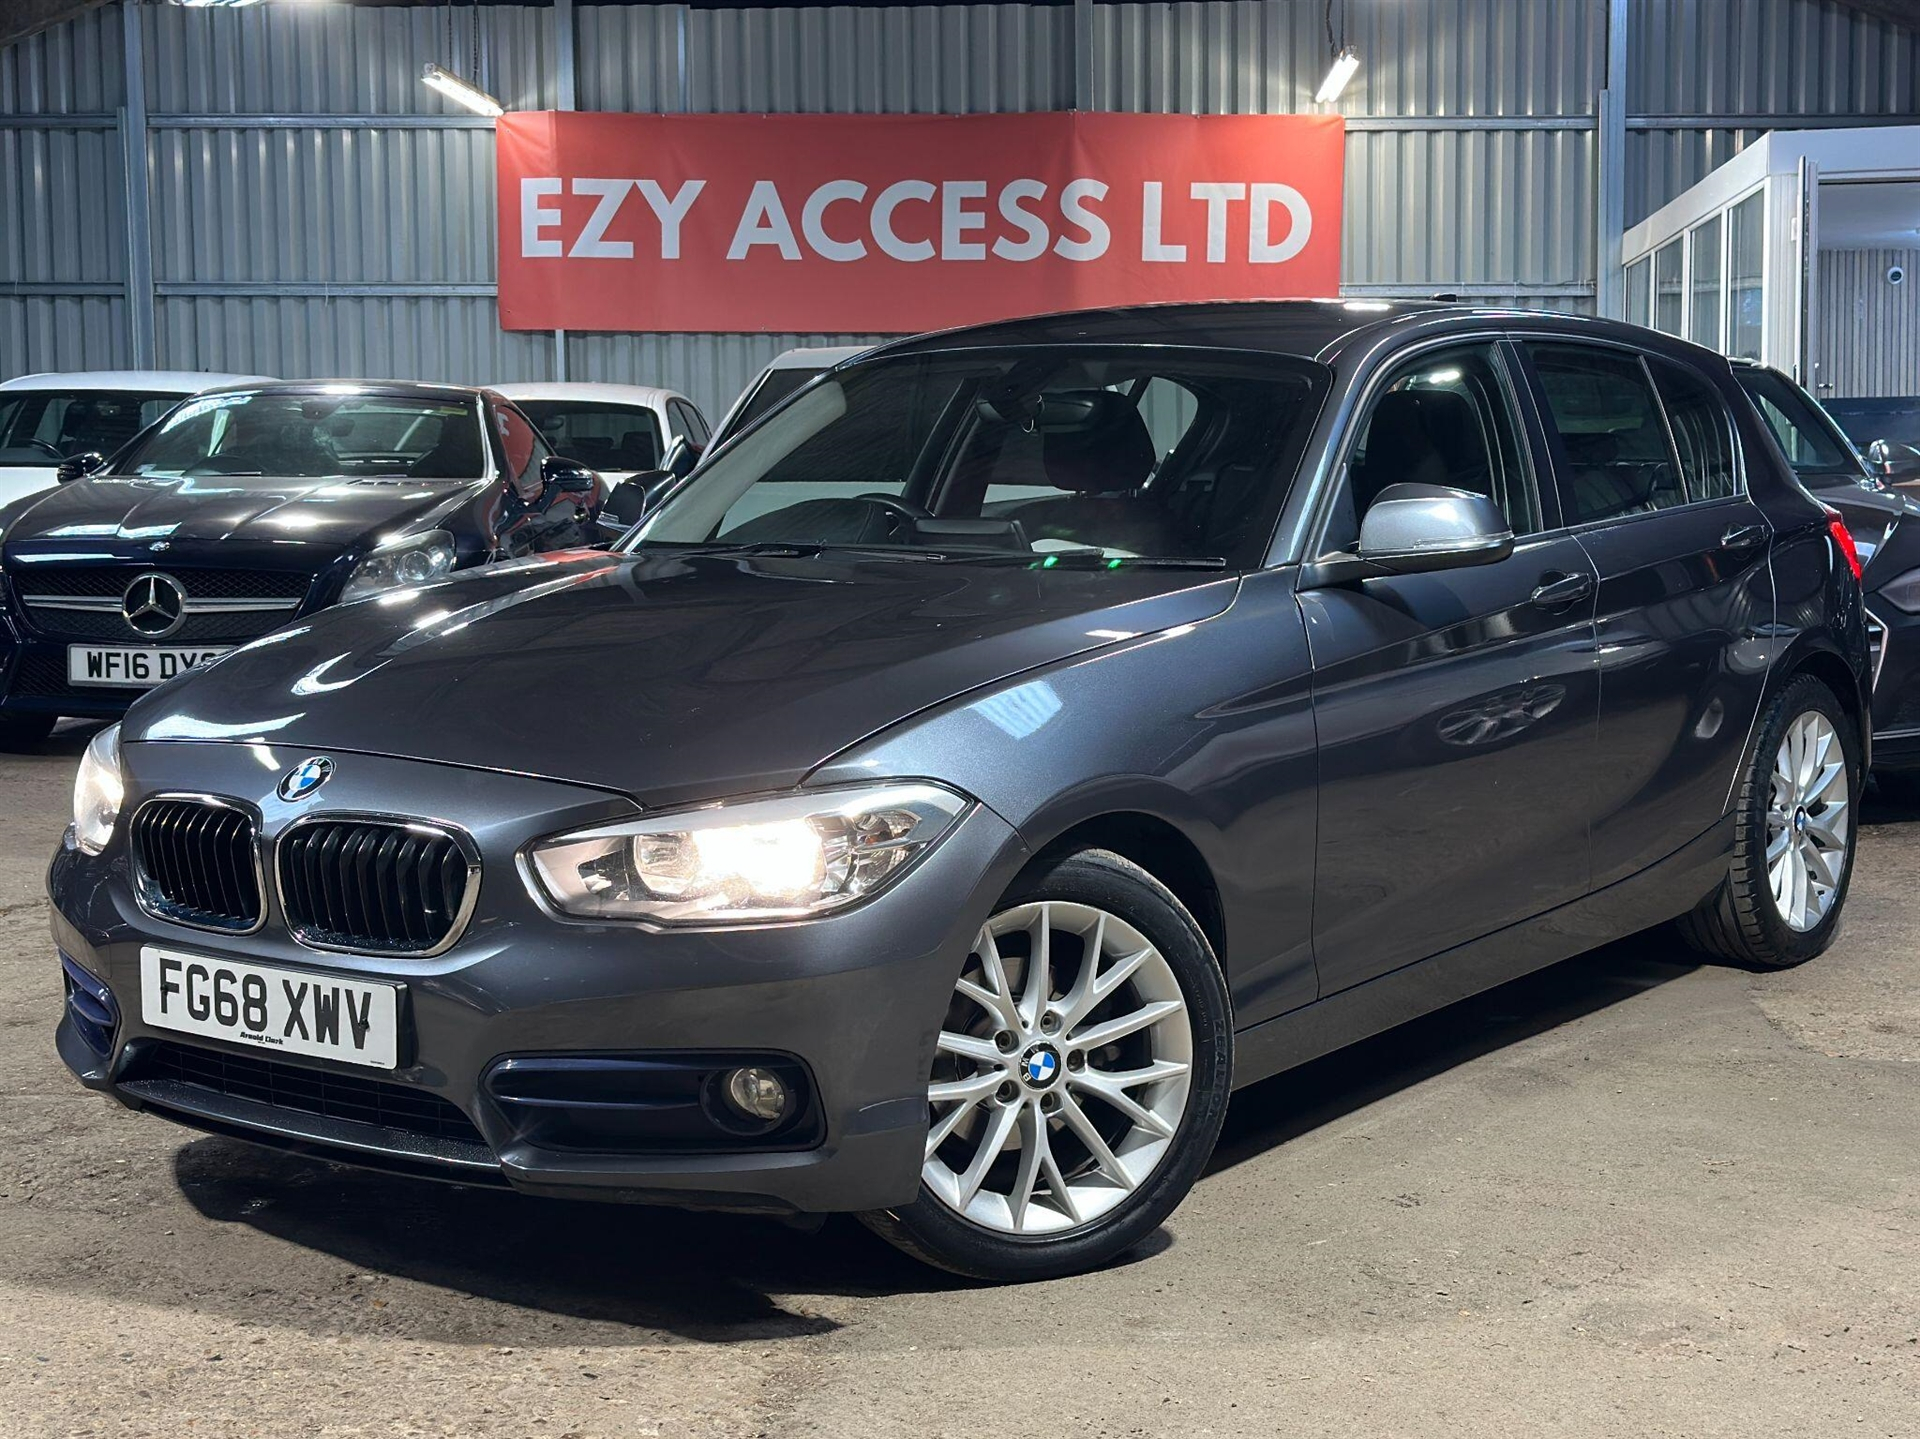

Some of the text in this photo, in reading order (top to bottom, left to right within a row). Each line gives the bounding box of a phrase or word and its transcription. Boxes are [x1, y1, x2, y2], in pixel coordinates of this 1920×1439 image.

[521, 177, 1313, 263] EZY ACCESS LTD
[87, 651, 149, 679] WF16
[159, 957, 372, 1050] FG68 XWV
